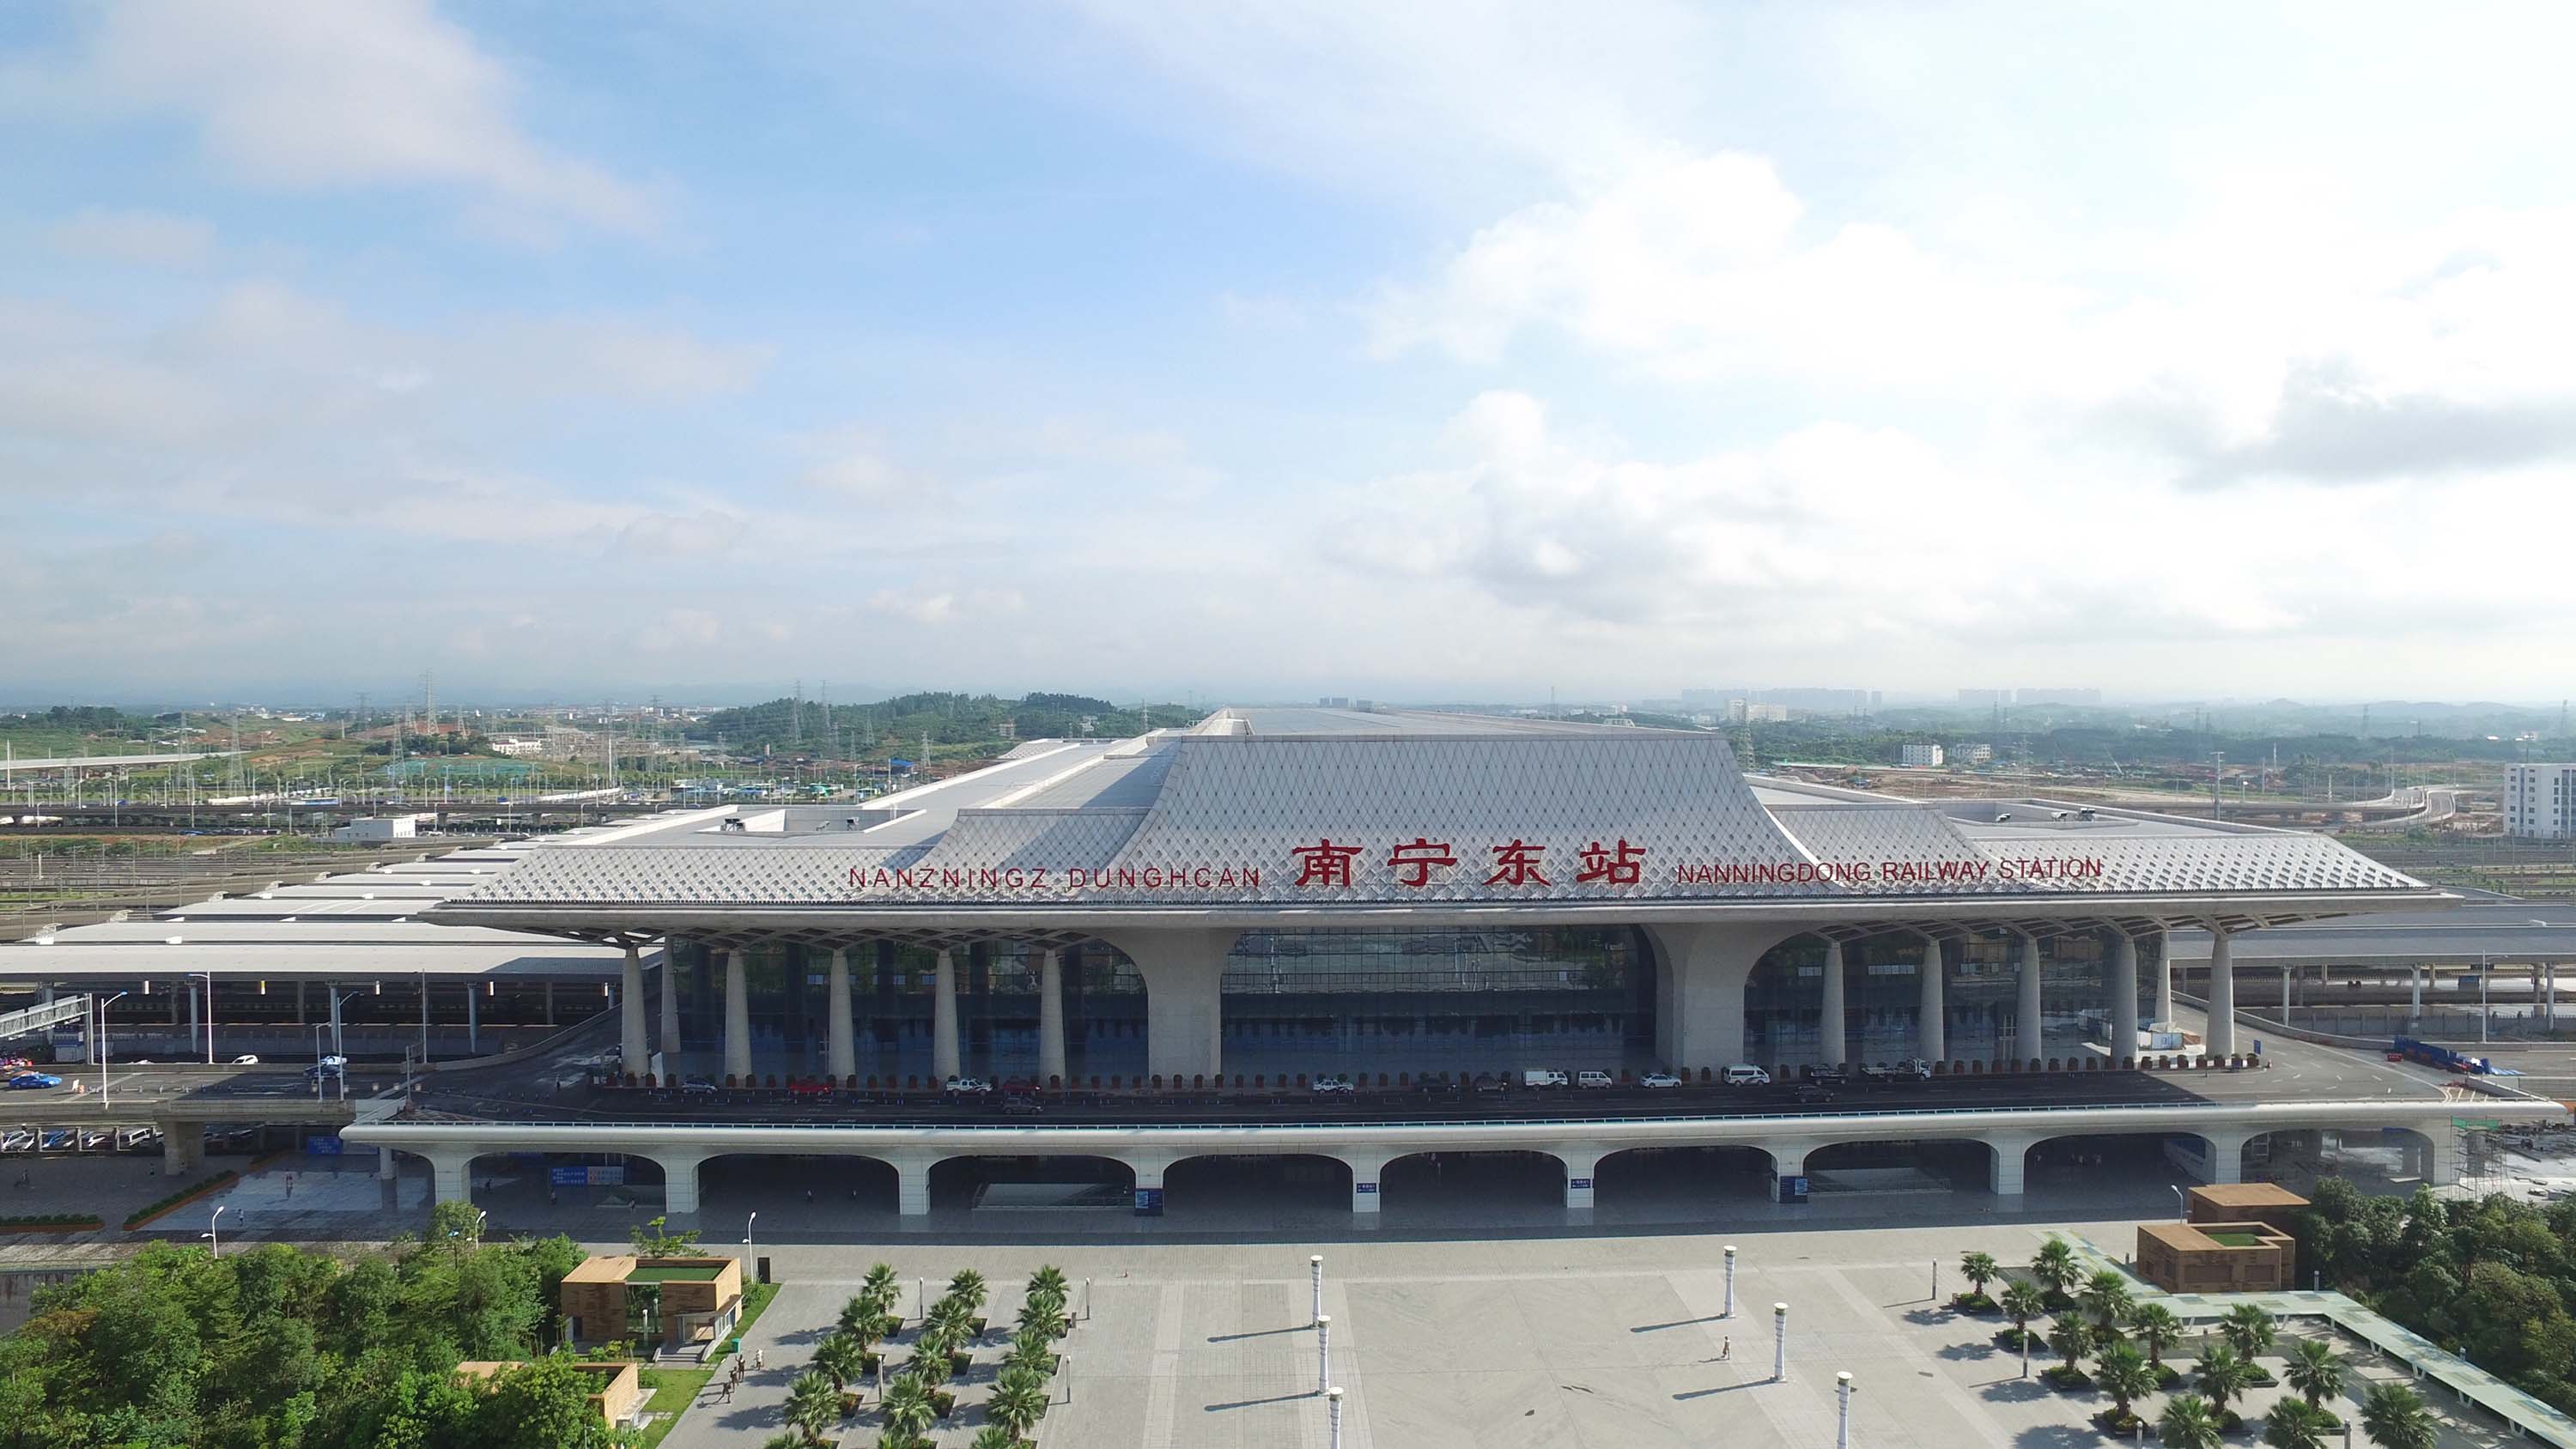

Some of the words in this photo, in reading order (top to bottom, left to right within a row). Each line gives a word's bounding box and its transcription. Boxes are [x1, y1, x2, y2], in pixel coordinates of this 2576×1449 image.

[1292, 838, 1646, 888] 南宁东站
[1678, 862, 1870, 883] NANNINGDONG
[1882, 861, 1990, 880] RAILWAY
[2000, 858, 2101, 879] STATION
[850, 868, 1047, 888] NANZNINGZ
[1069, 867, 1260, 888] DUNGHCAN
